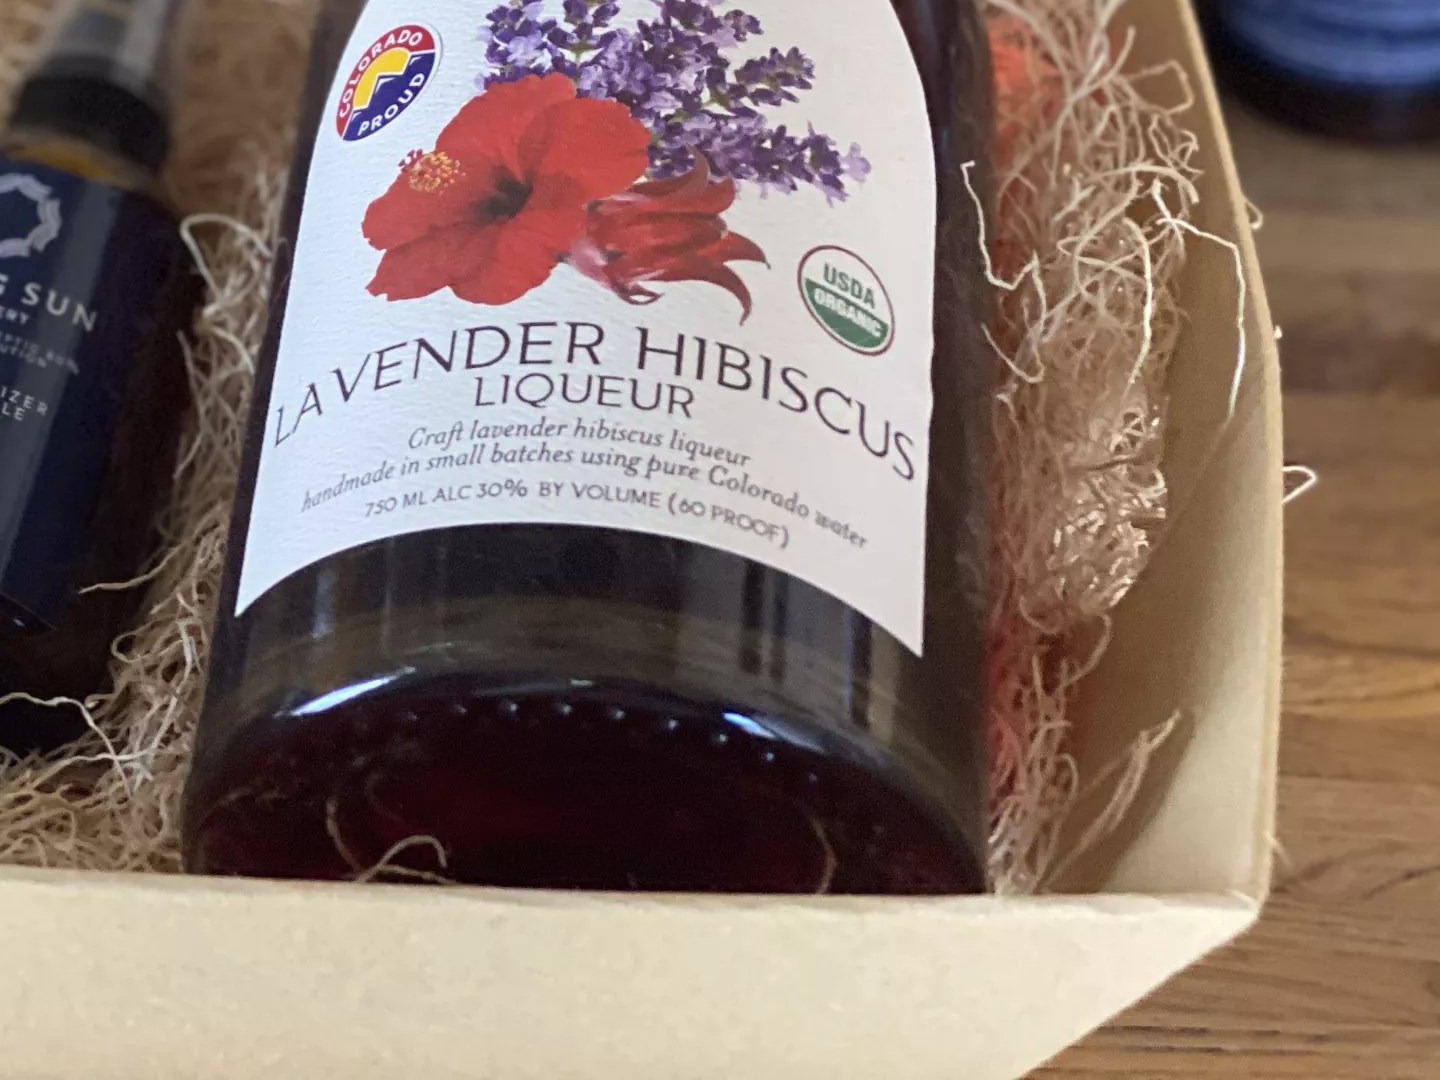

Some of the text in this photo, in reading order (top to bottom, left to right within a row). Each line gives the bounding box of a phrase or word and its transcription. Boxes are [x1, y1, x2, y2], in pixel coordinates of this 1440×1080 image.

[339, 29, 423, 118] COLORADO
[357, 73, 425, 136] PROUD
[20, 281, 97, 332] SUN
[813, 286, 882, 338] ORGANIC
[823, 261, 876, 310] USDA
[274, 321, 915, 482] LAVENDER HIBISCUS
[475, 373, 695, 418] LIQUEUR
[409, 416, 752, 467] Craft lavender hibiscus liqueur
[301, 442, 868, 549] handmade in small batches using pure Colorado water
[365, 479, 790, 549] 750 ML ALC 30% BY VOLUME (60 PROOF)
